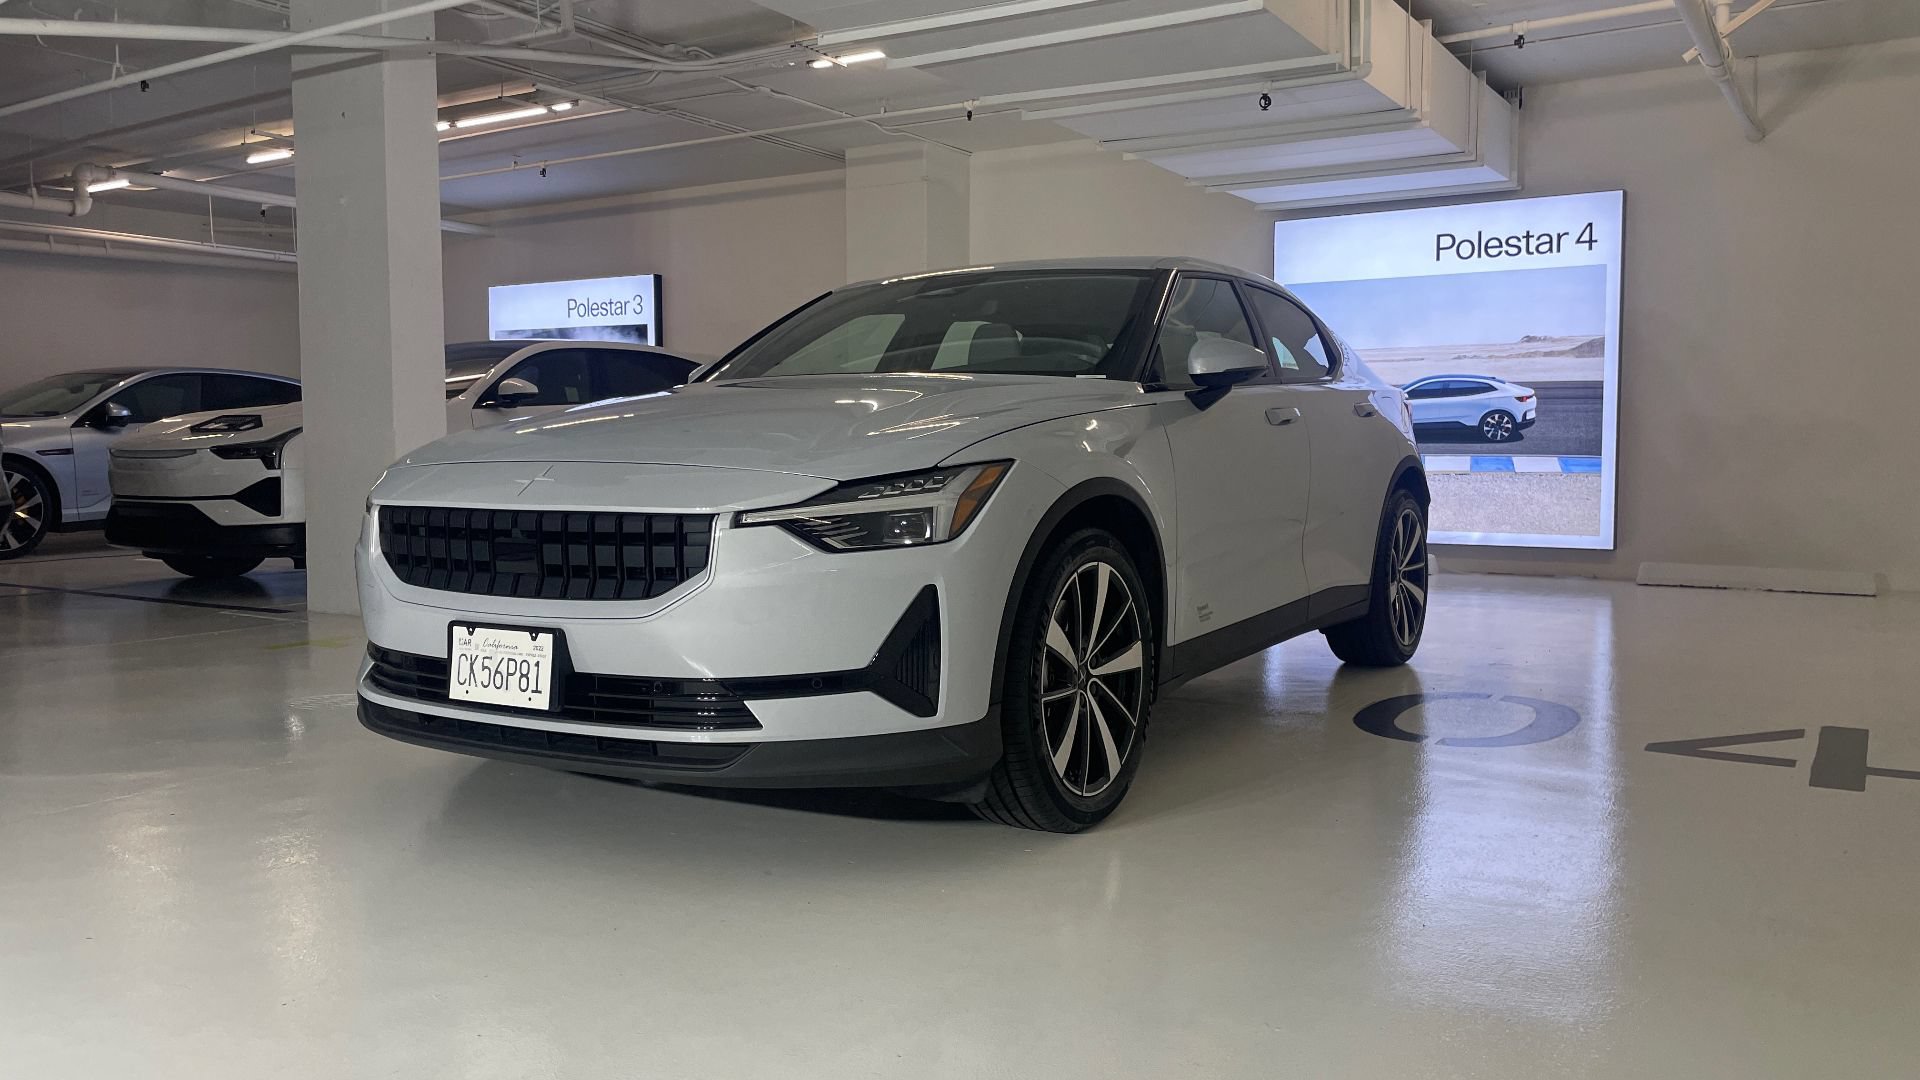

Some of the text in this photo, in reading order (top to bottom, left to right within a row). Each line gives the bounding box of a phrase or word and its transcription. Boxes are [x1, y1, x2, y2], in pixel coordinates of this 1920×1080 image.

[1435, 221, 1598, 262] Polestar 4
[567, 294, 643, 318] Polestar 3
[457, 653, 543, 694] CK56P81
